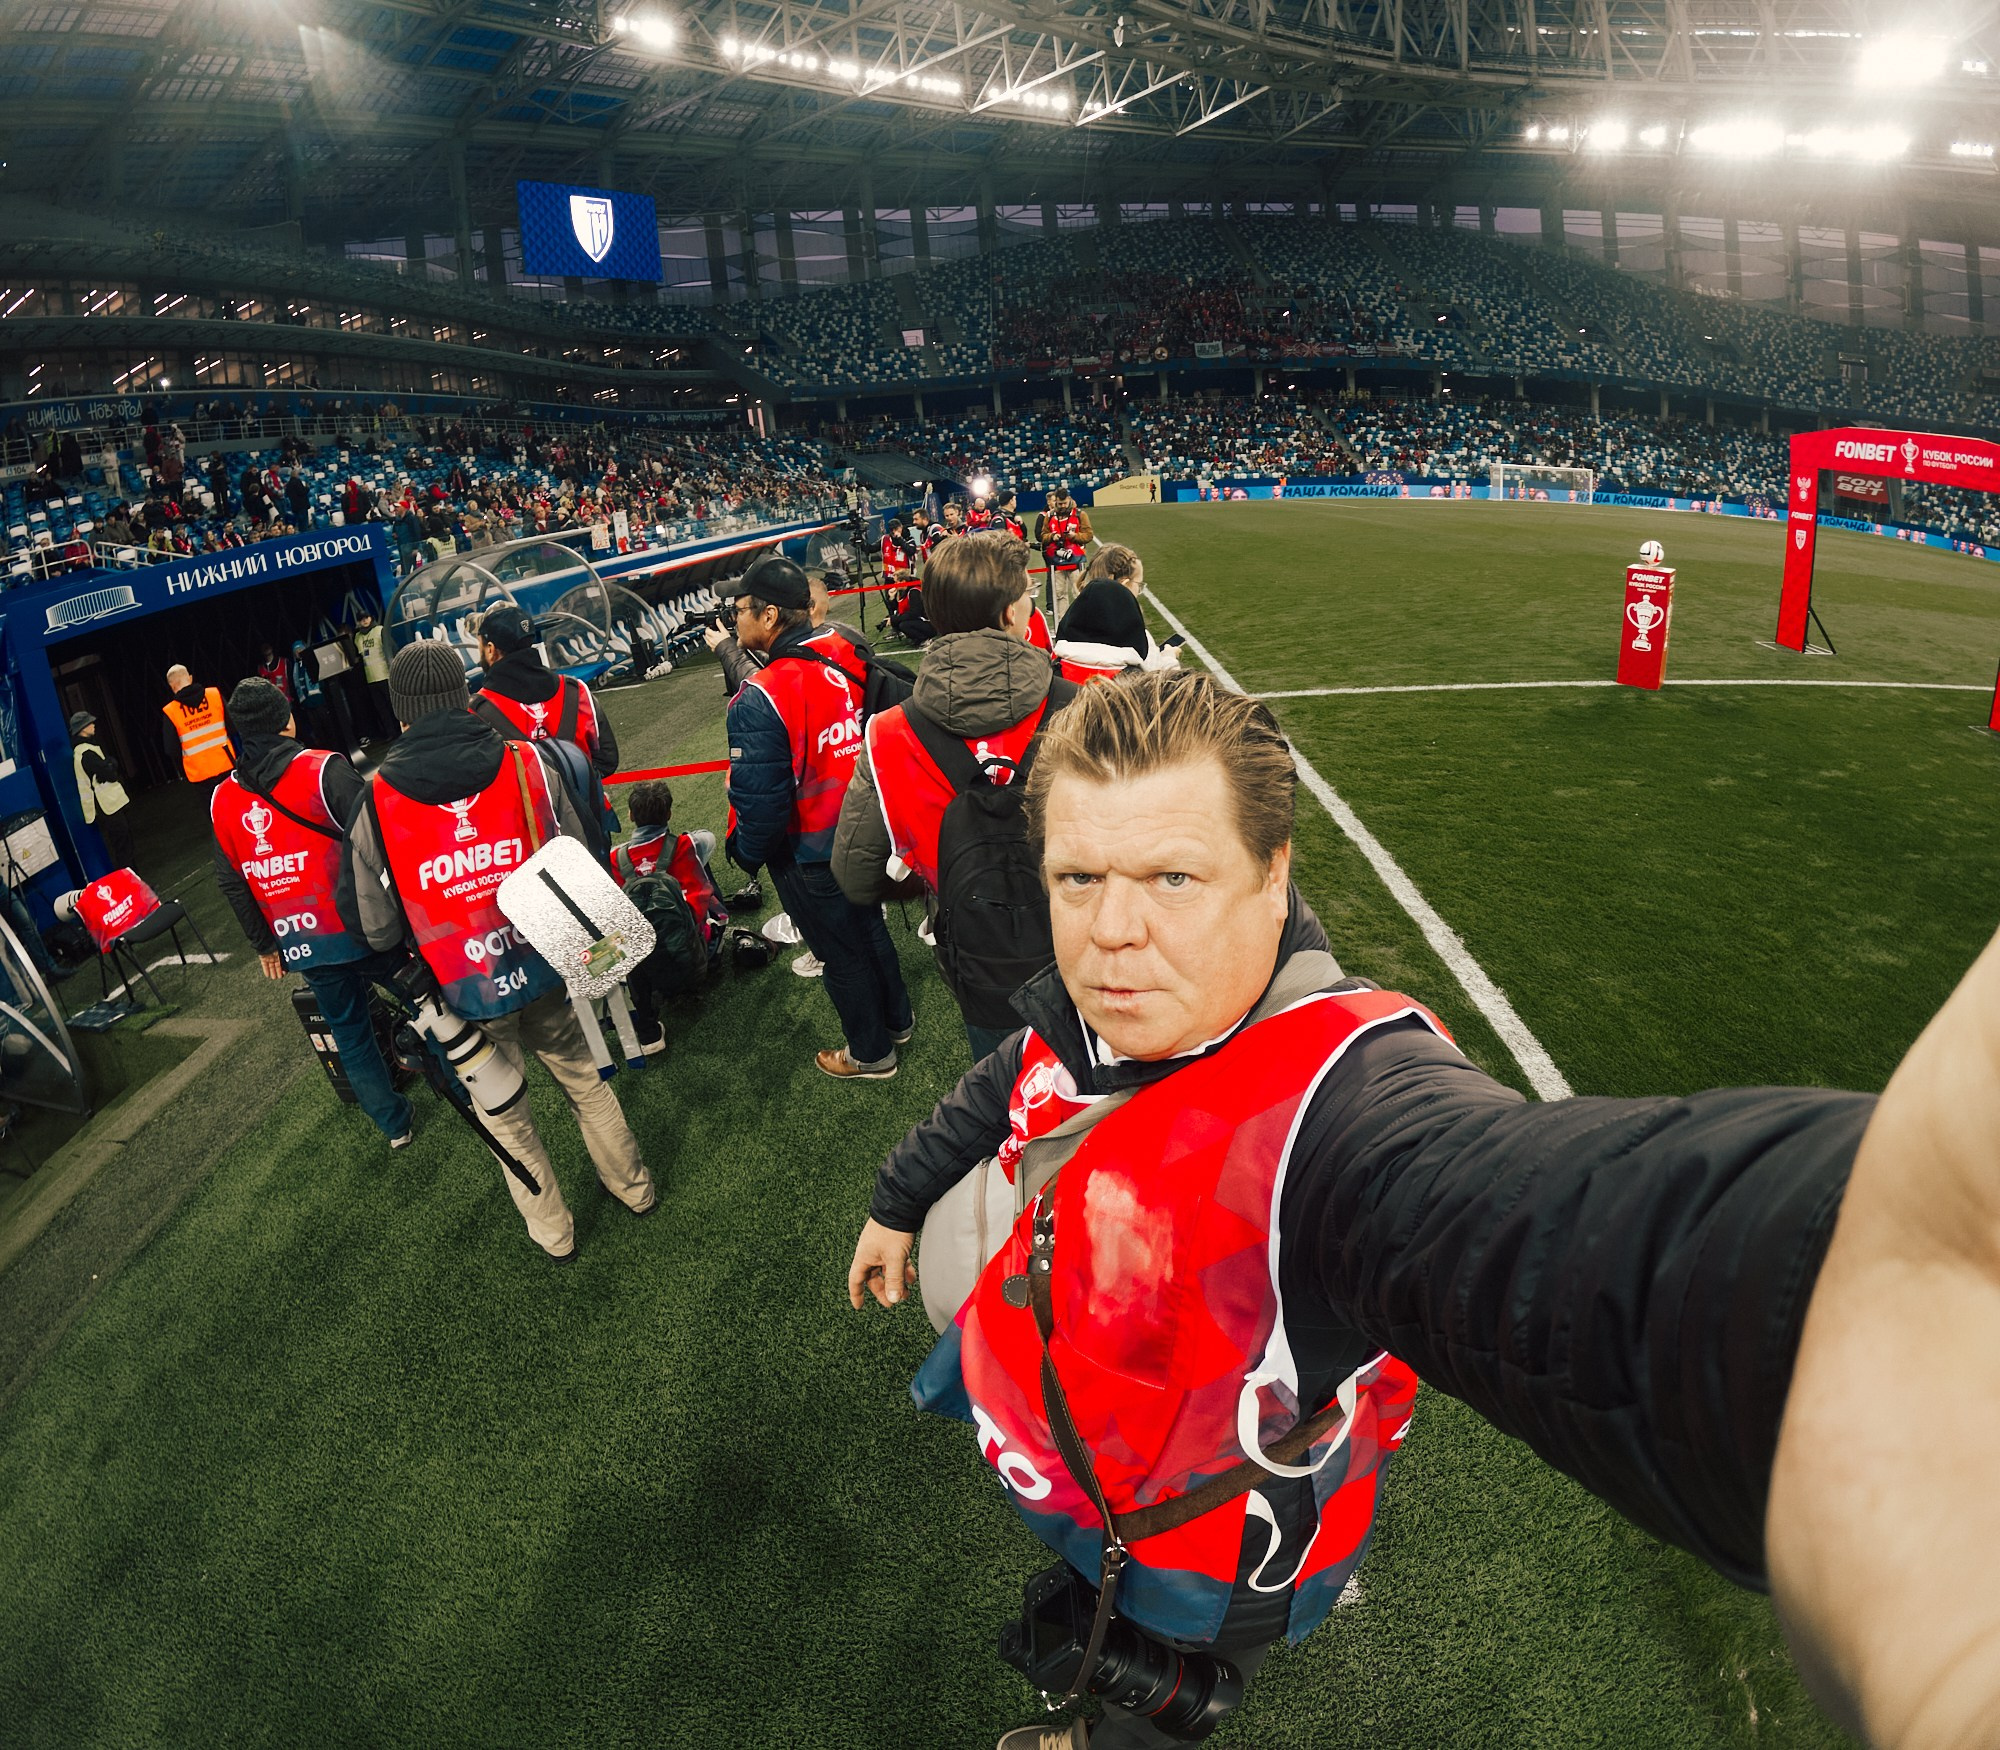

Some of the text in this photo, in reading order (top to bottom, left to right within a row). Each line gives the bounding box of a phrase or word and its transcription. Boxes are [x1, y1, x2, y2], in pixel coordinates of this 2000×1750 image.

[1835, 440, 1897, 463] FONBET
[1922, 449, 1994, 468] КУБОК РОССИИ
[1282, 485, 1399, 498] НАША КОМАНДА
[1837, 475, 1883, 489] FON
[1837, 482, 1884, 496] BET
[1613, 495, 1667, 508] КОМАНДА
[166, 534, 373, 595] НИЖНИЙ НОВГОРОД
[1632, 573, 1665, 584] FONBET
[442, 879, 478, 899] КУБОК
[102, 894, 133, 925] FONBET
[273, 911, 318, 937] ОТО
[493, 966, 528, 997] 304
